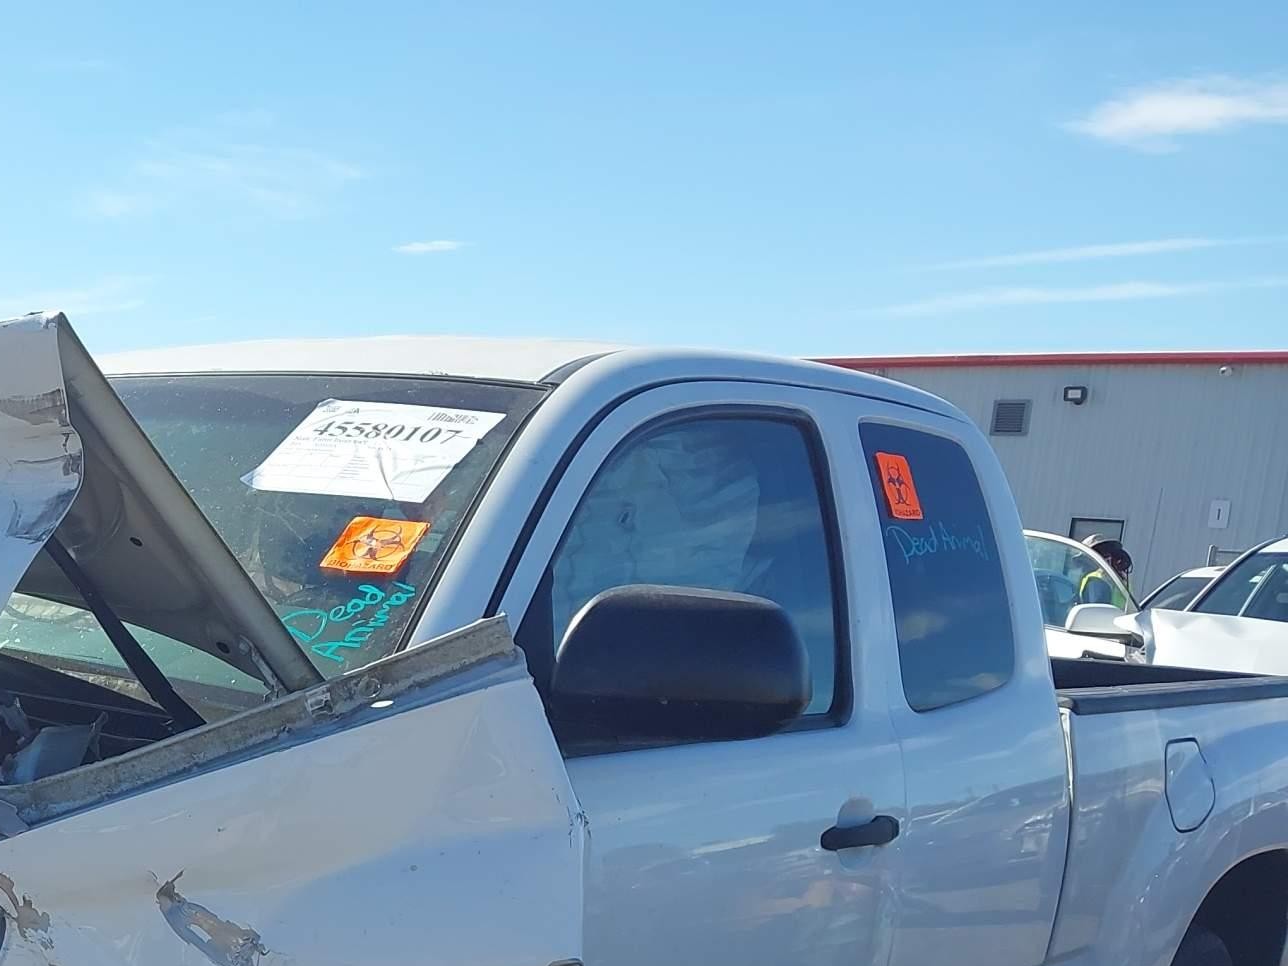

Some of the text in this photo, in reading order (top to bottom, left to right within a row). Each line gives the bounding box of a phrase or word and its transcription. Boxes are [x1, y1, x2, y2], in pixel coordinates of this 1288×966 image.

[312, 420, 462, 445] 45580107
[886, 524, 937, 565] Dead
[282, 584, 385, 643] Dead
[311, 581, 416, 662] Animal
